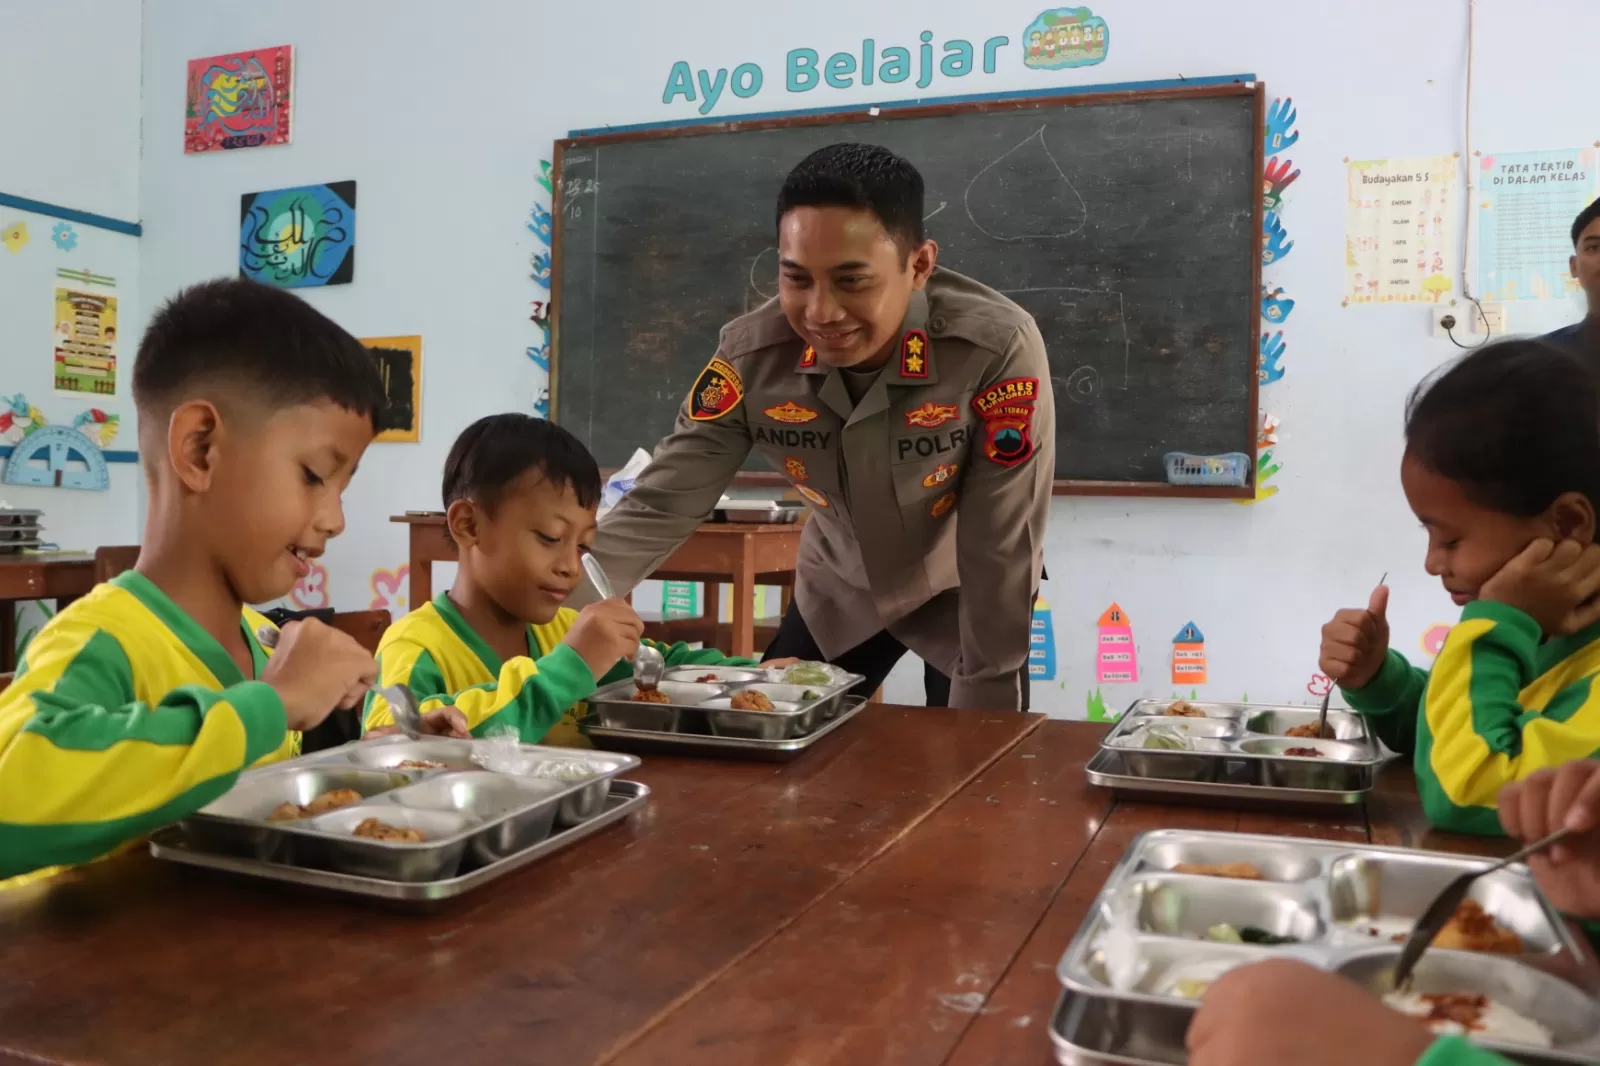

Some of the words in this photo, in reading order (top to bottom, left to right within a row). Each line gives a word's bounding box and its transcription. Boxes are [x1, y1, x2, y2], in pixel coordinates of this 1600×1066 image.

[662, 60, 763, 115] Ayo
[785, 30, 1009, 93] Belajar
[1501, 164, 1529, 174] TATA
[1533, 160, 1574, 172] TERTIB
[1362, 173, 1413, 187] Budayakan
[1415, 172, 1422, 182] 5
[1424, 171, 1430, 182] S
[1493, 177, 1504, 185] DI
[1507, 174, 1546, 185] DALAM
[1550, 171, 1585, 182] KELAS
[977, 380, 1033, 408] POLRES
[755, 427, 831, 451] ANDRY
[898, 423, 970, 460] POLRI
[1111, 610, 1121, 622] 8
[1185, 628, 1195, 639] 9
